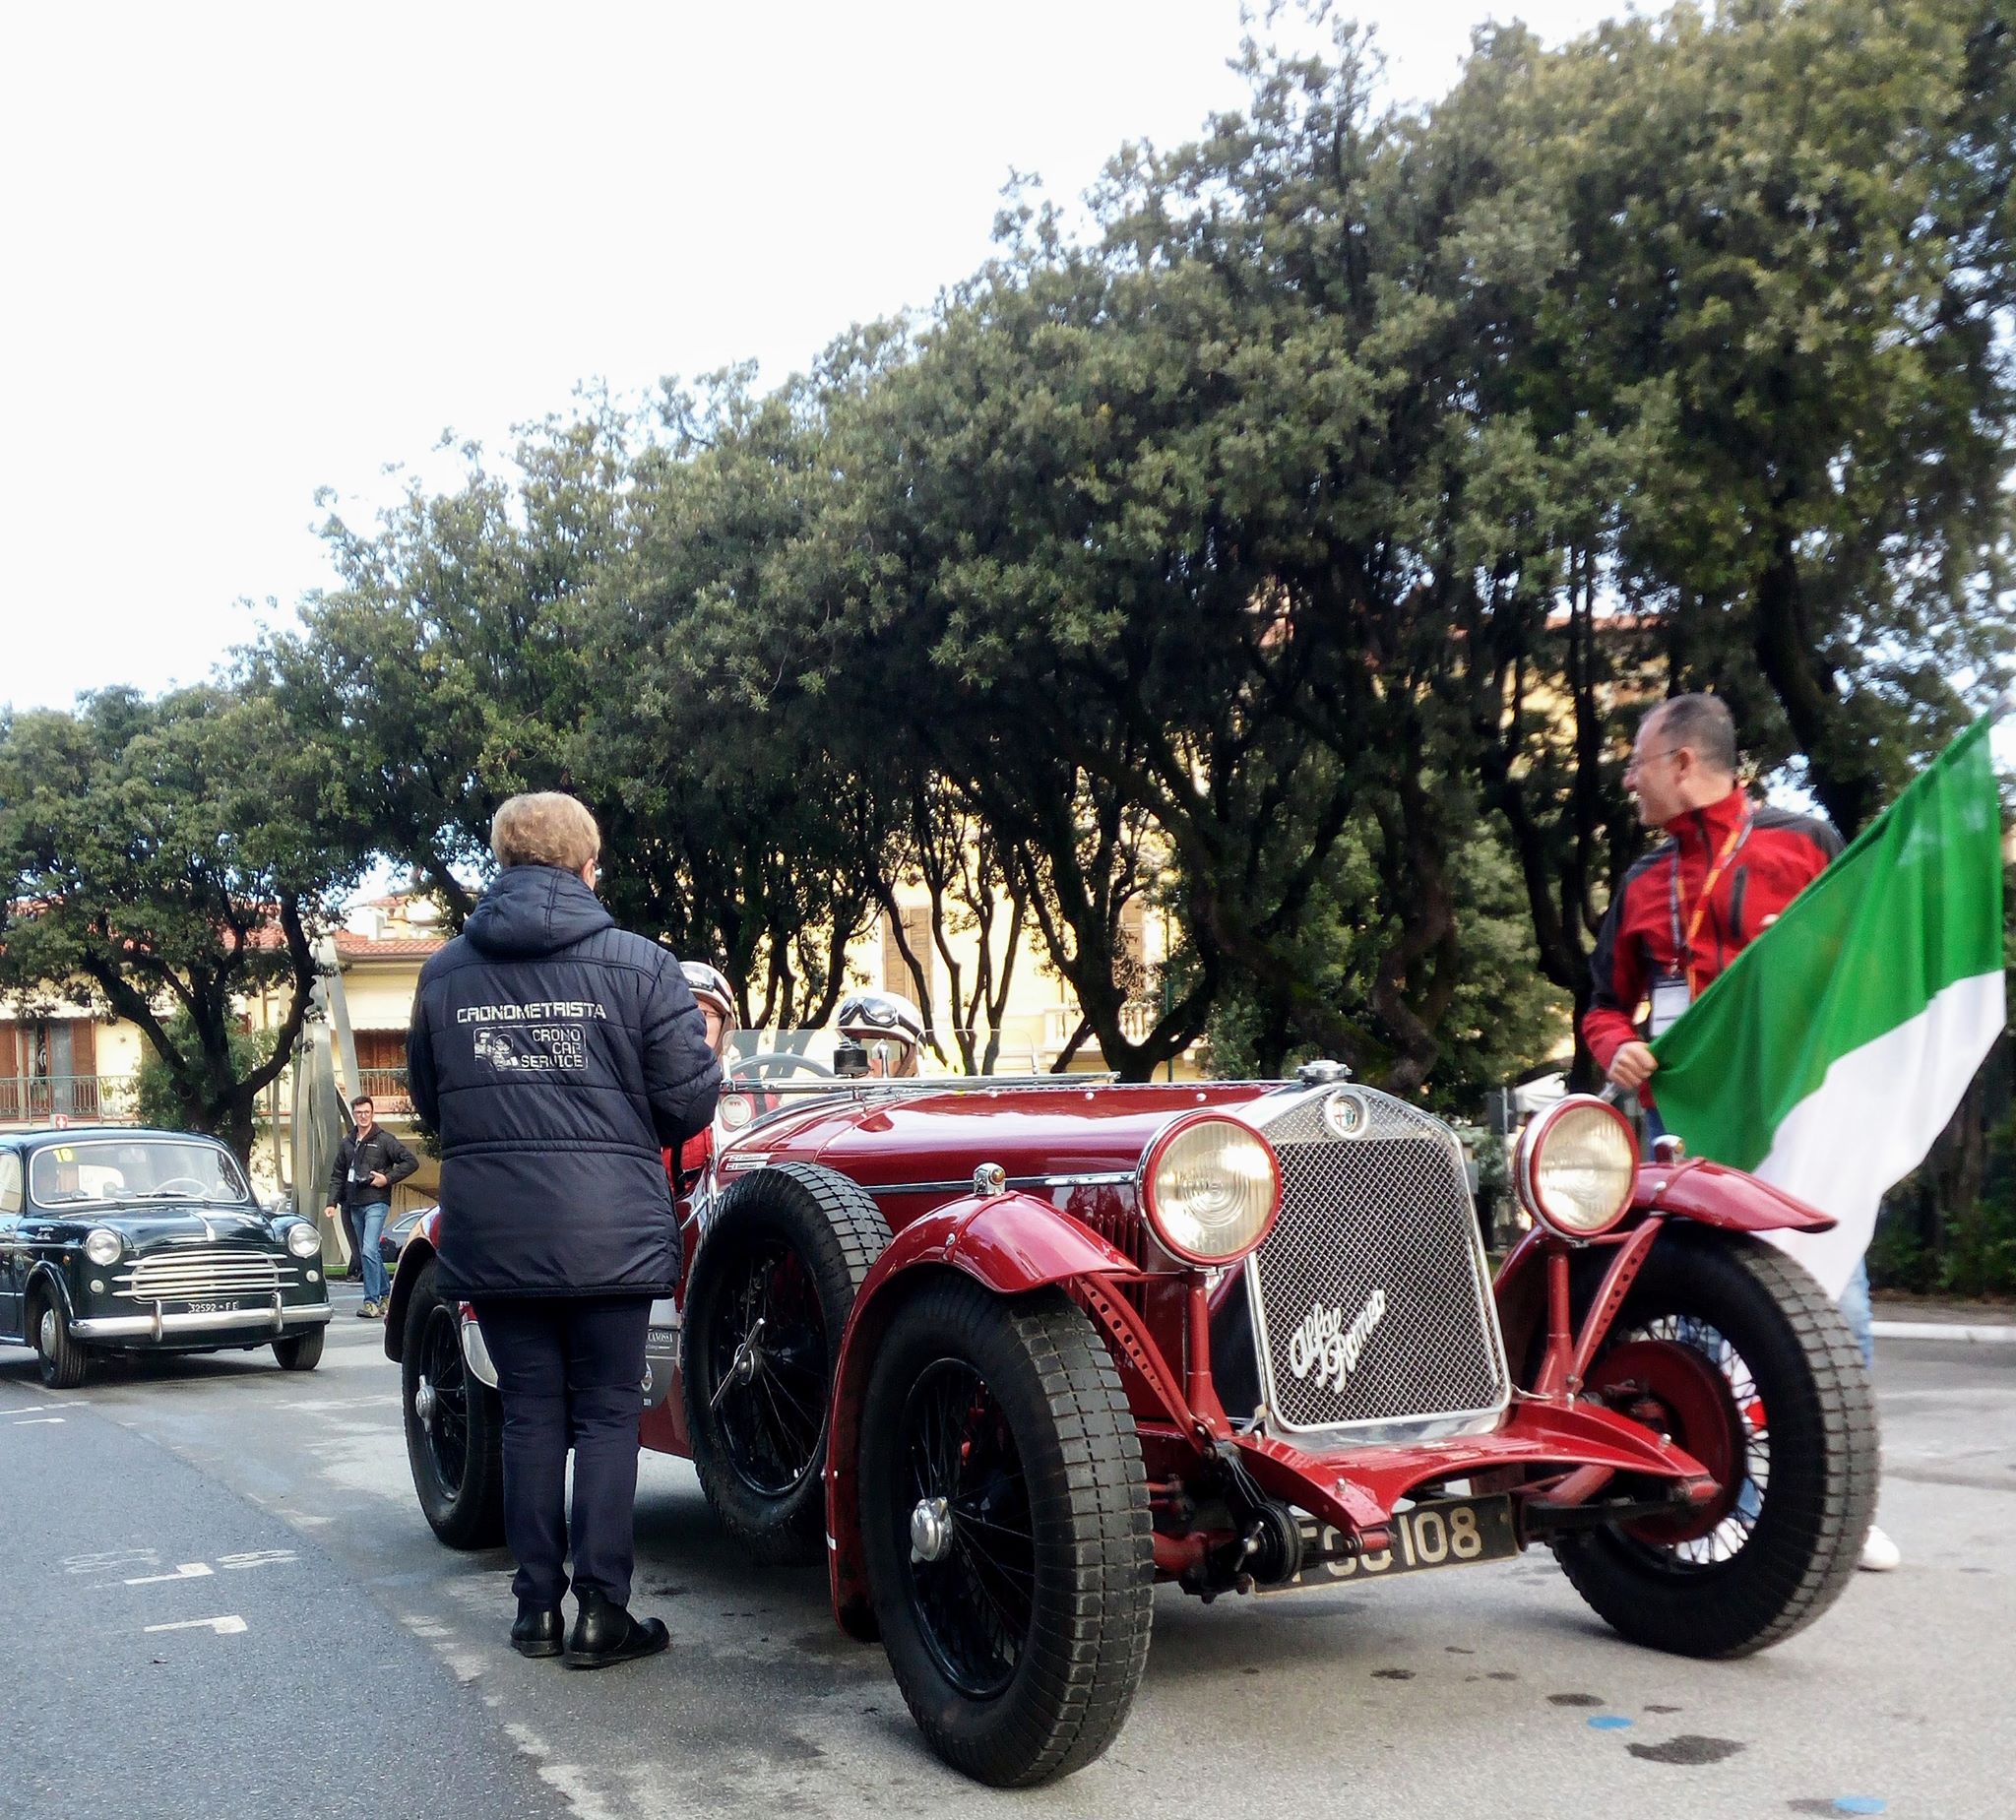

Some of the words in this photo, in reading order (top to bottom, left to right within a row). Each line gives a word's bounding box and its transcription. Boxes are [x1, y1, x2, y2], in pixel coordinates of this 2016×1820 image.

[457, 1001, 607, 1024] CRONOMETRISTA
[532, 1029, 581, 1042] CRONO
[551, 1042, 582, 1055] CAR
[521, 1055, 583, 1068] SERVICE
[1399, 1506, 1482, 1566] 108
